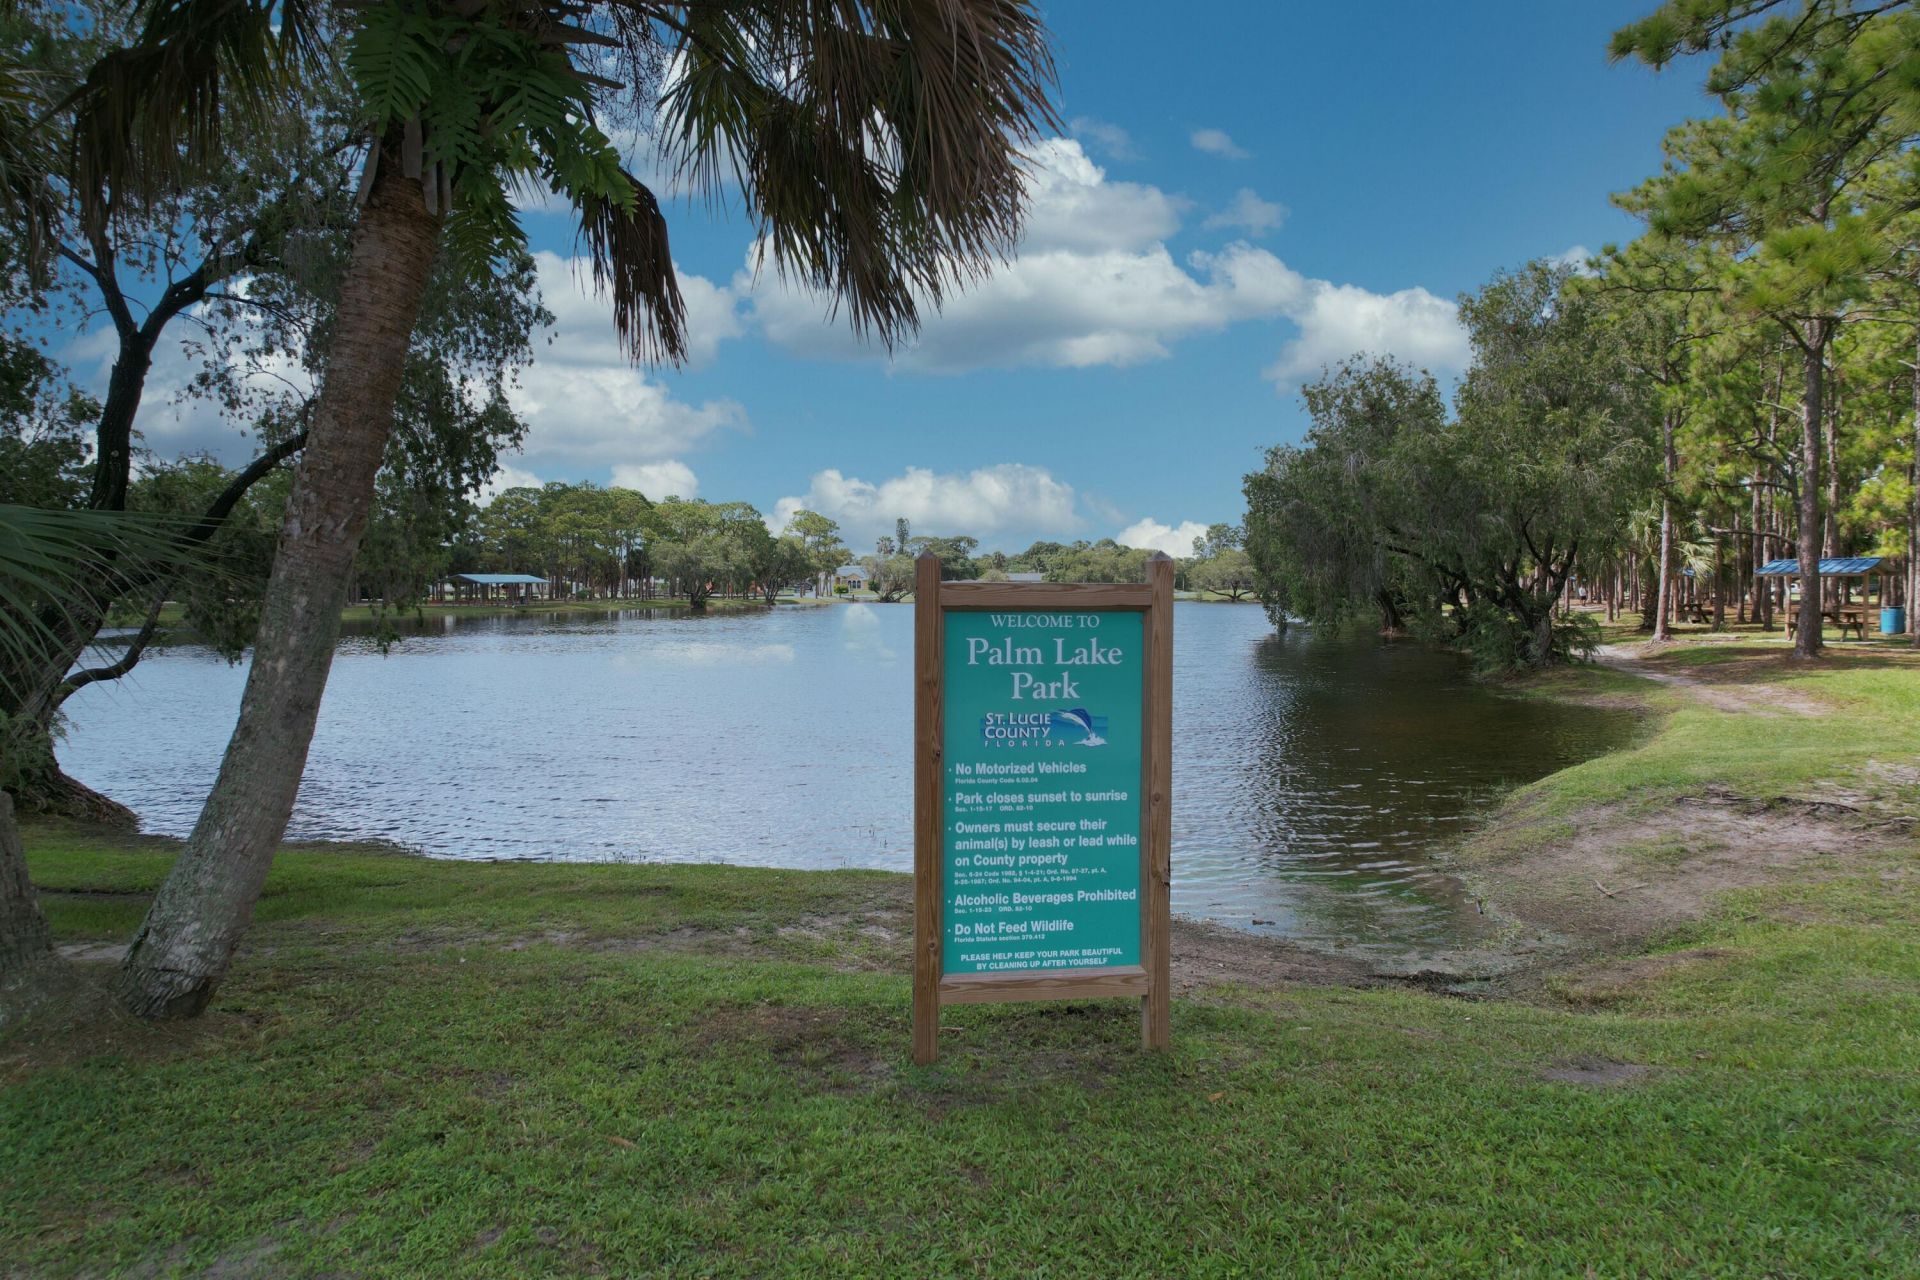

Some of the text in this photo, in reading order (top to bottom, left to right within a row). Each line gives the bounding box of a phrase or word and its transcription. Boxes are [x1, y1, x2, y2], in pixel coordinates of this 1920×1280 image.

[991, 615, 1099, 628] WELCOME TO
[966, 637, 1122, 665] Palm Lake
[1011, 671, 1080, 700] Park
[985, 712, 1051, 725] ST. LUCIE
[984, 727, 1050, 739] COUNTY
[956, 762, 1086, 775] No Motorized Vehicles
[956, 790, 1128, 804] Park closes sunset to sunrise
[956, 819, 1107, 833] Owners must secure their
[955, 834, 1137, 851] animal(s) by leash or lead while
[955, 853, 1068, 867] on County property
[954, 889, 1136, 906] Alcoholic Beverages Prohibited
[955, 920, 1074, 935] Do Not Feed Wildlife
[960, 953, 990, 961] PLEASE
[1082, 948, 1123, 956] BEAUTIFUL
[989, 961, 1028, 970] CLEANING
[1068, 958, 1108, 966] YOURSELF
